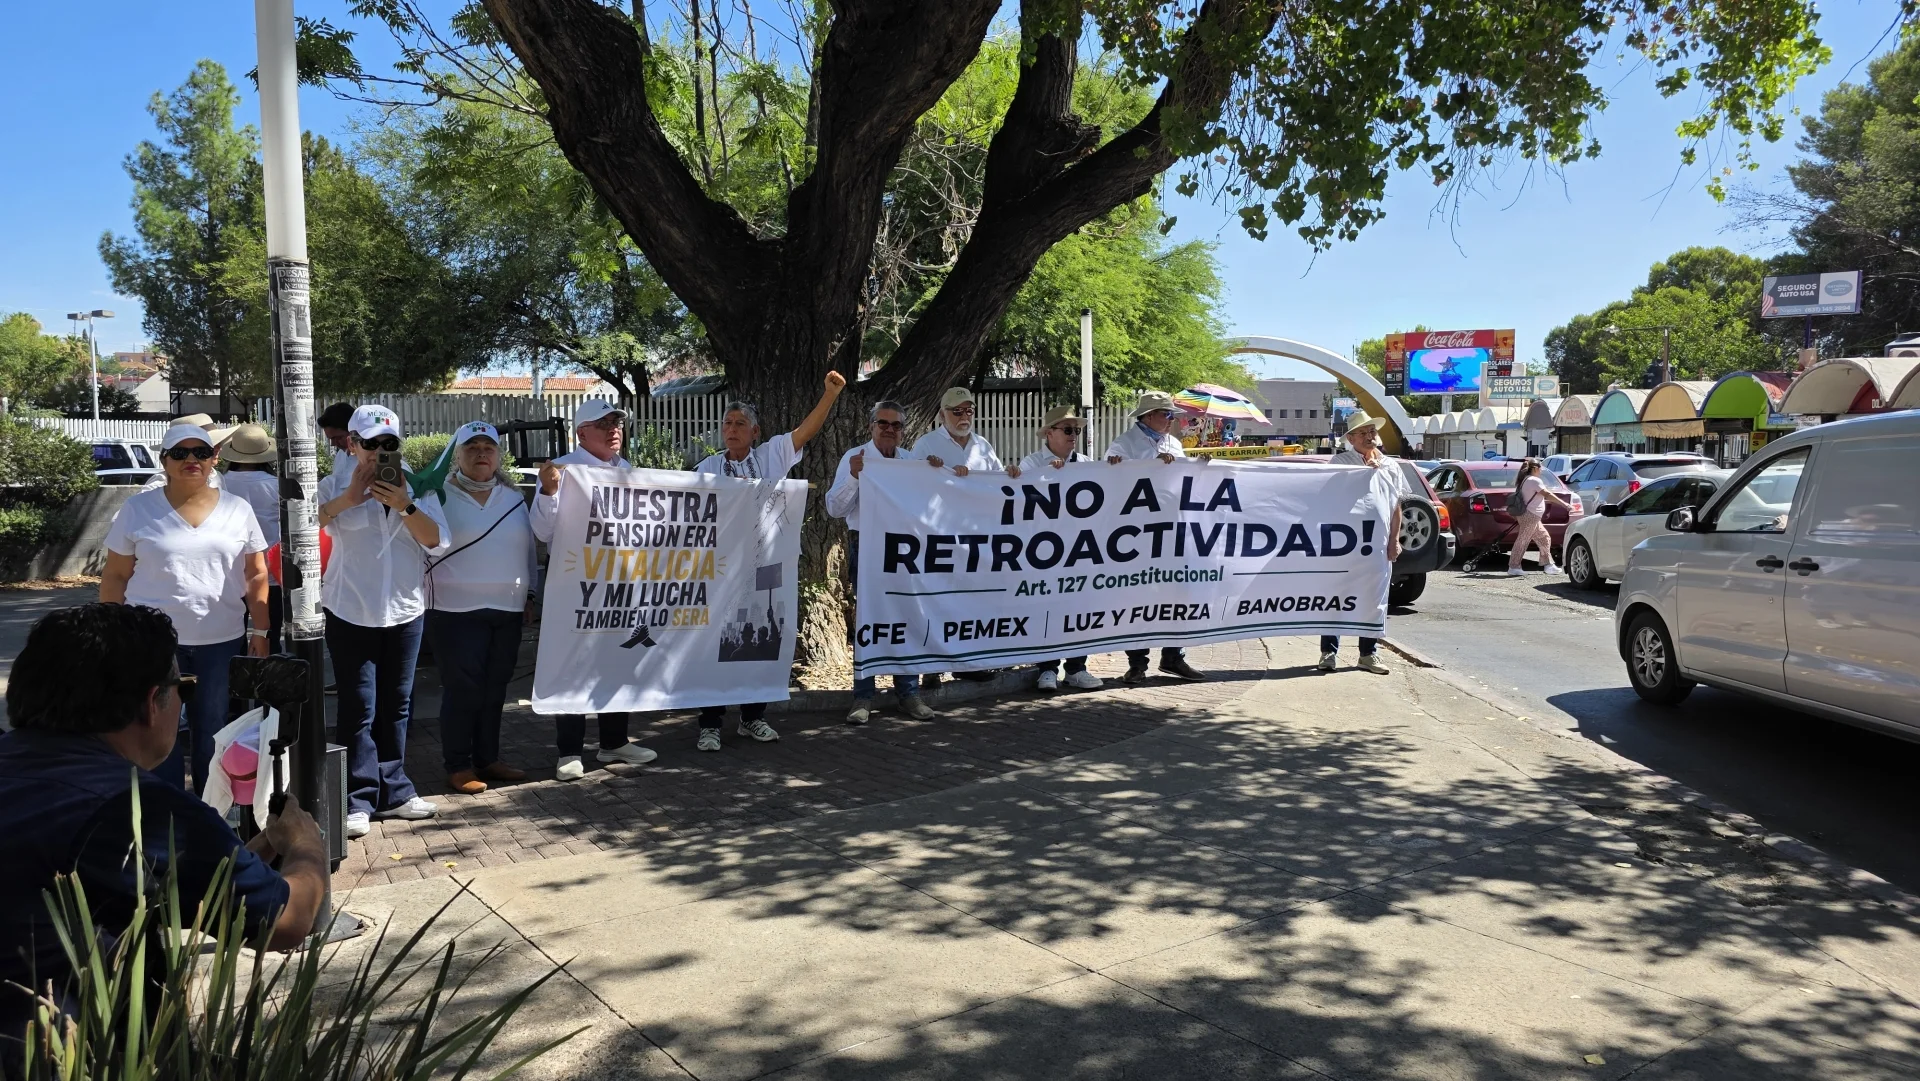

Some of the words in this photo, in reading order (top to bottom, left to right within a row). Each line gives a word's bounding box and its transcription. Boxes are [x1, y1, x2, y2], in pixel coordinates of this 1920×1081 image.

[1777, 283, 1817, 291] SEGUROS
[1494, 378, 1532, 386] SEGUROS
[590, 486, 717, 523] NUESTRA
[1001, 480, 1104, 525] ¡NO
[1120, 477, 1161, 515] A
[1179, 475, 1242, 512] LA
[585, 521, 681, 547] PENSIÓN
[683, 525, 717, 548] ERA
[883, 520, 1375, 574] RETROACTIVIDAD!
[582, 548, 715, 581] VITALICIA
[579, 581, 598, 607] Y
[603, 582, 633, 608] MI
[639, 581, 707, 607] LUCHA
[1015, 580, 1051, 597] Art.
[1057, 576, 1087, 594] 127
[1092, 565, 1225, 590] Constitucional
[574, 607, 646, 630] TAMBIÉN
[650, 609, 668, 627] LO
[672, 604, 710, 627] SERÁ
[856, 622, 907, 648] CFE
[943, 616, 1029, 643] PEMEX
[1063, 611, 1105, 633] LUZ
[1111, 608, 1127, 626] Y
[1129, 603, 1210, 625] FUERZA
[1236, 595, 1357, 616] BANOBRAS
